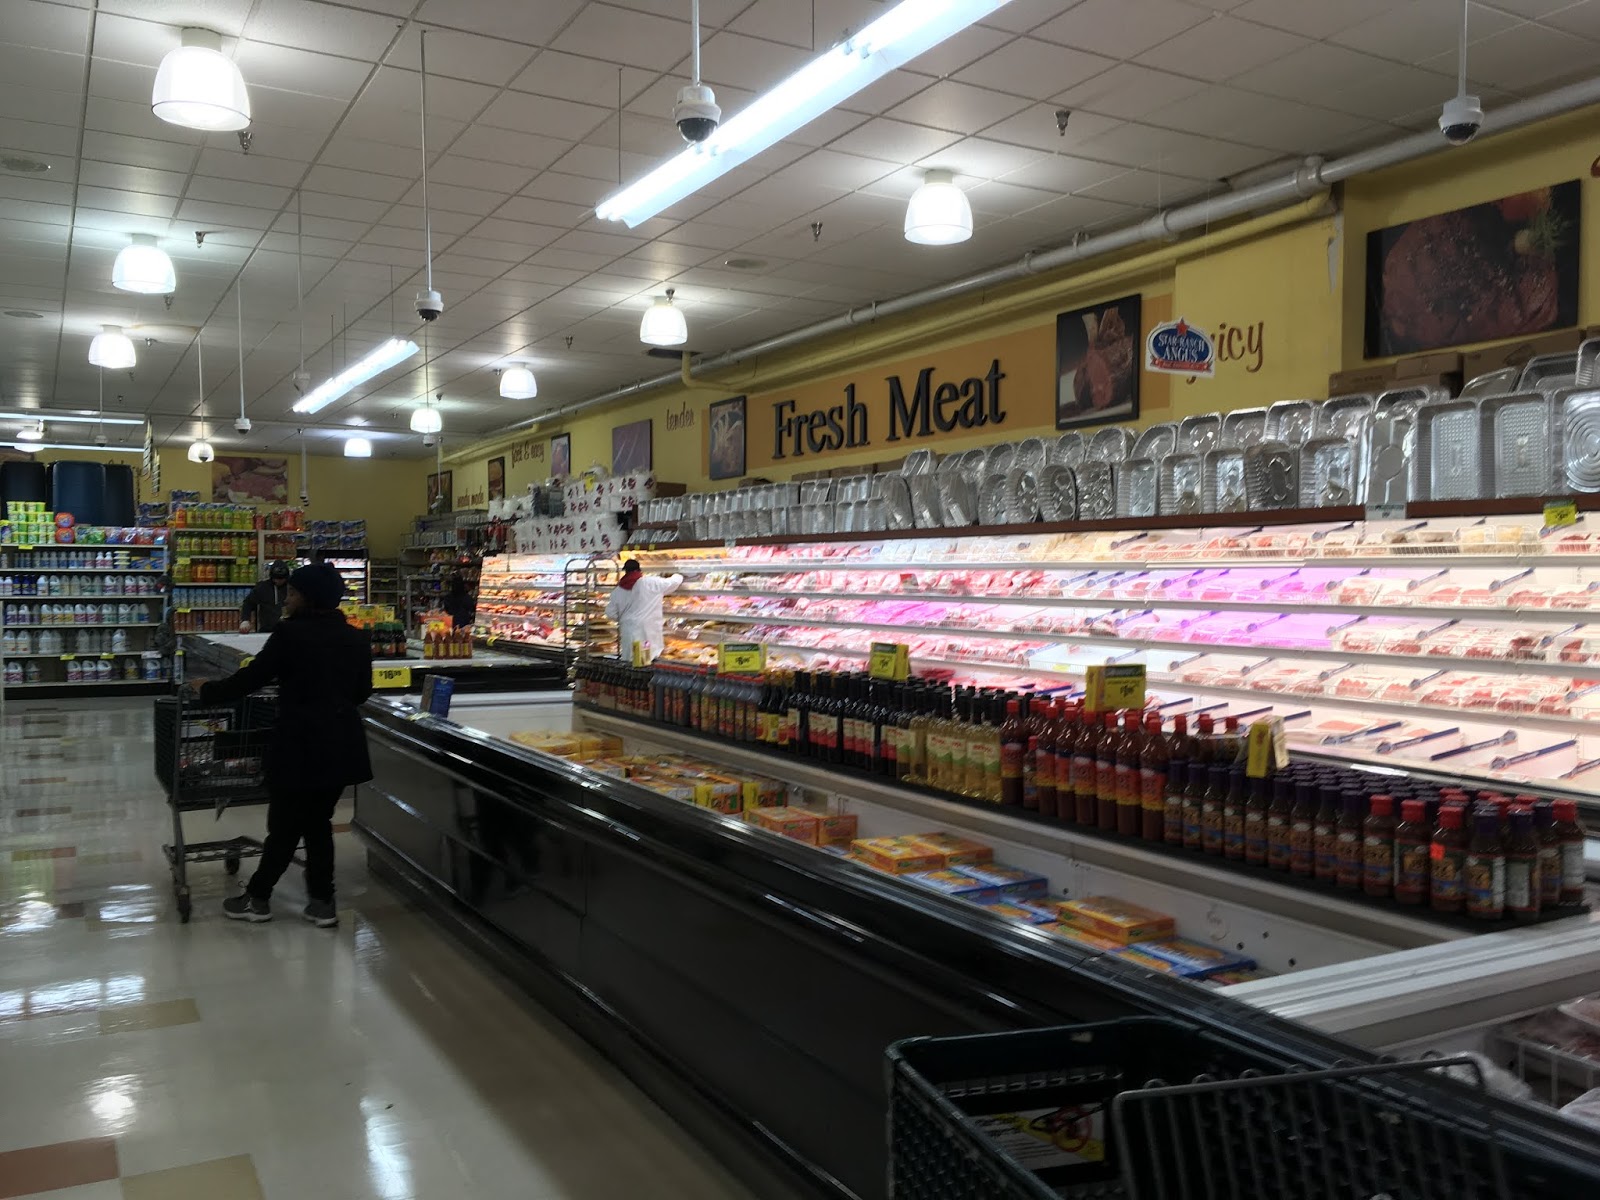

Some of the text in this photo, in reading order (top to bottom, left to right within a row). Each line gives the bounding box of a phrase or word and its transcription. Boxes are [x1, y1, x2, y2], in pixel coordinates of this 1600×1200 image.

[1158, 332, 1205, 353] STAR RANCH
[1163, 346, 1199, 363] ANGUS
[772, 359, 1006, 459] Fresh Meat
